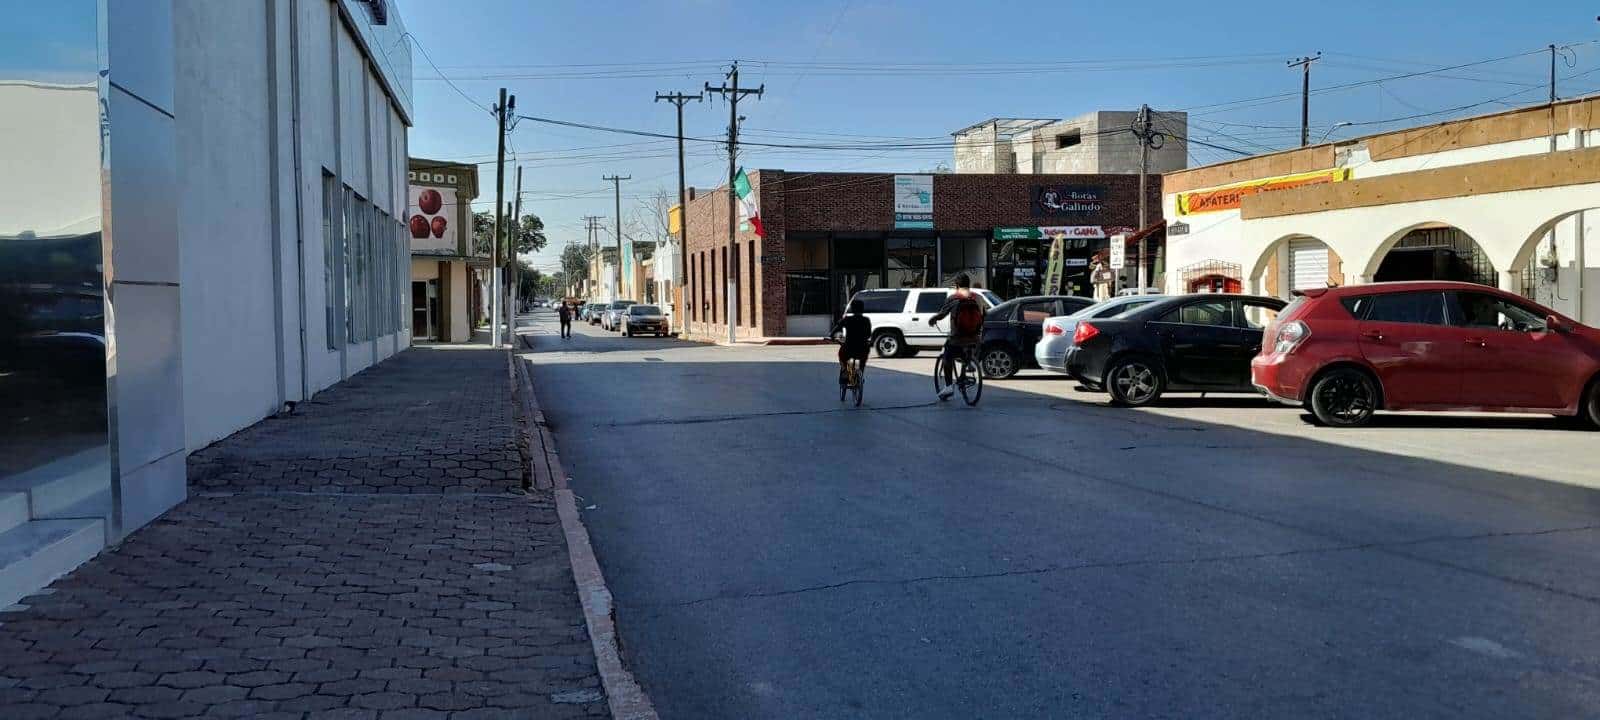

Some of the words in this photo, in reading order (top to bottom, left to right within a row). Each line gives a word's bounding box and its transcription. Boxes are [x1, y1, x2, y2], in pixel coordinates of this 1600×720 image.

[1071, 191, 1097, 200] Botas
[1188, 190, 1245, 212] ZAPATERI
[1061, 202, 1101, 211] Galindo
[1074, 227, 1098, 236] GANA
